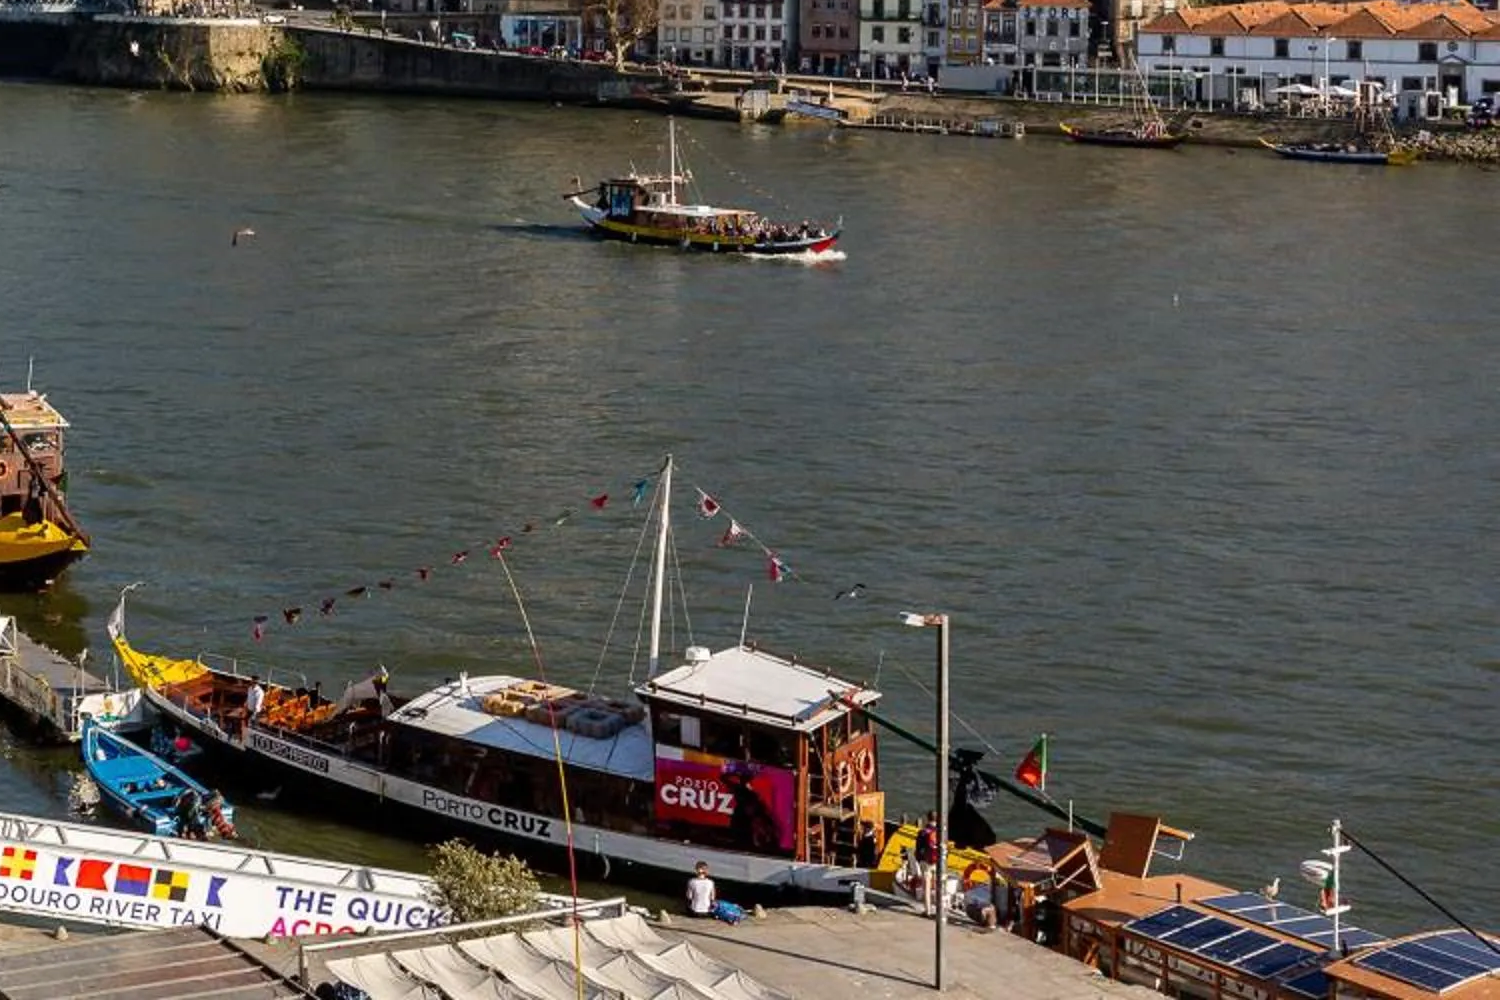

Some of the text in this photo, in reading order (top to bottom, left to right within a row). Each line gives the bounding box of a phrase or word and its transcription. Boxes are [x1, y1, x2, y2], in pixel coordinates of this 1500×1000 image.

[675, 775, 719, 791] PORTO
[423, 790, 551, 837] PORTO CRUZ
[660, 784, 735, 815] CRUZ
[89, 896, 160, 922] RIVER
[171, 908, 221, 930] TAXI
[276, 886, 336, 916] THE
